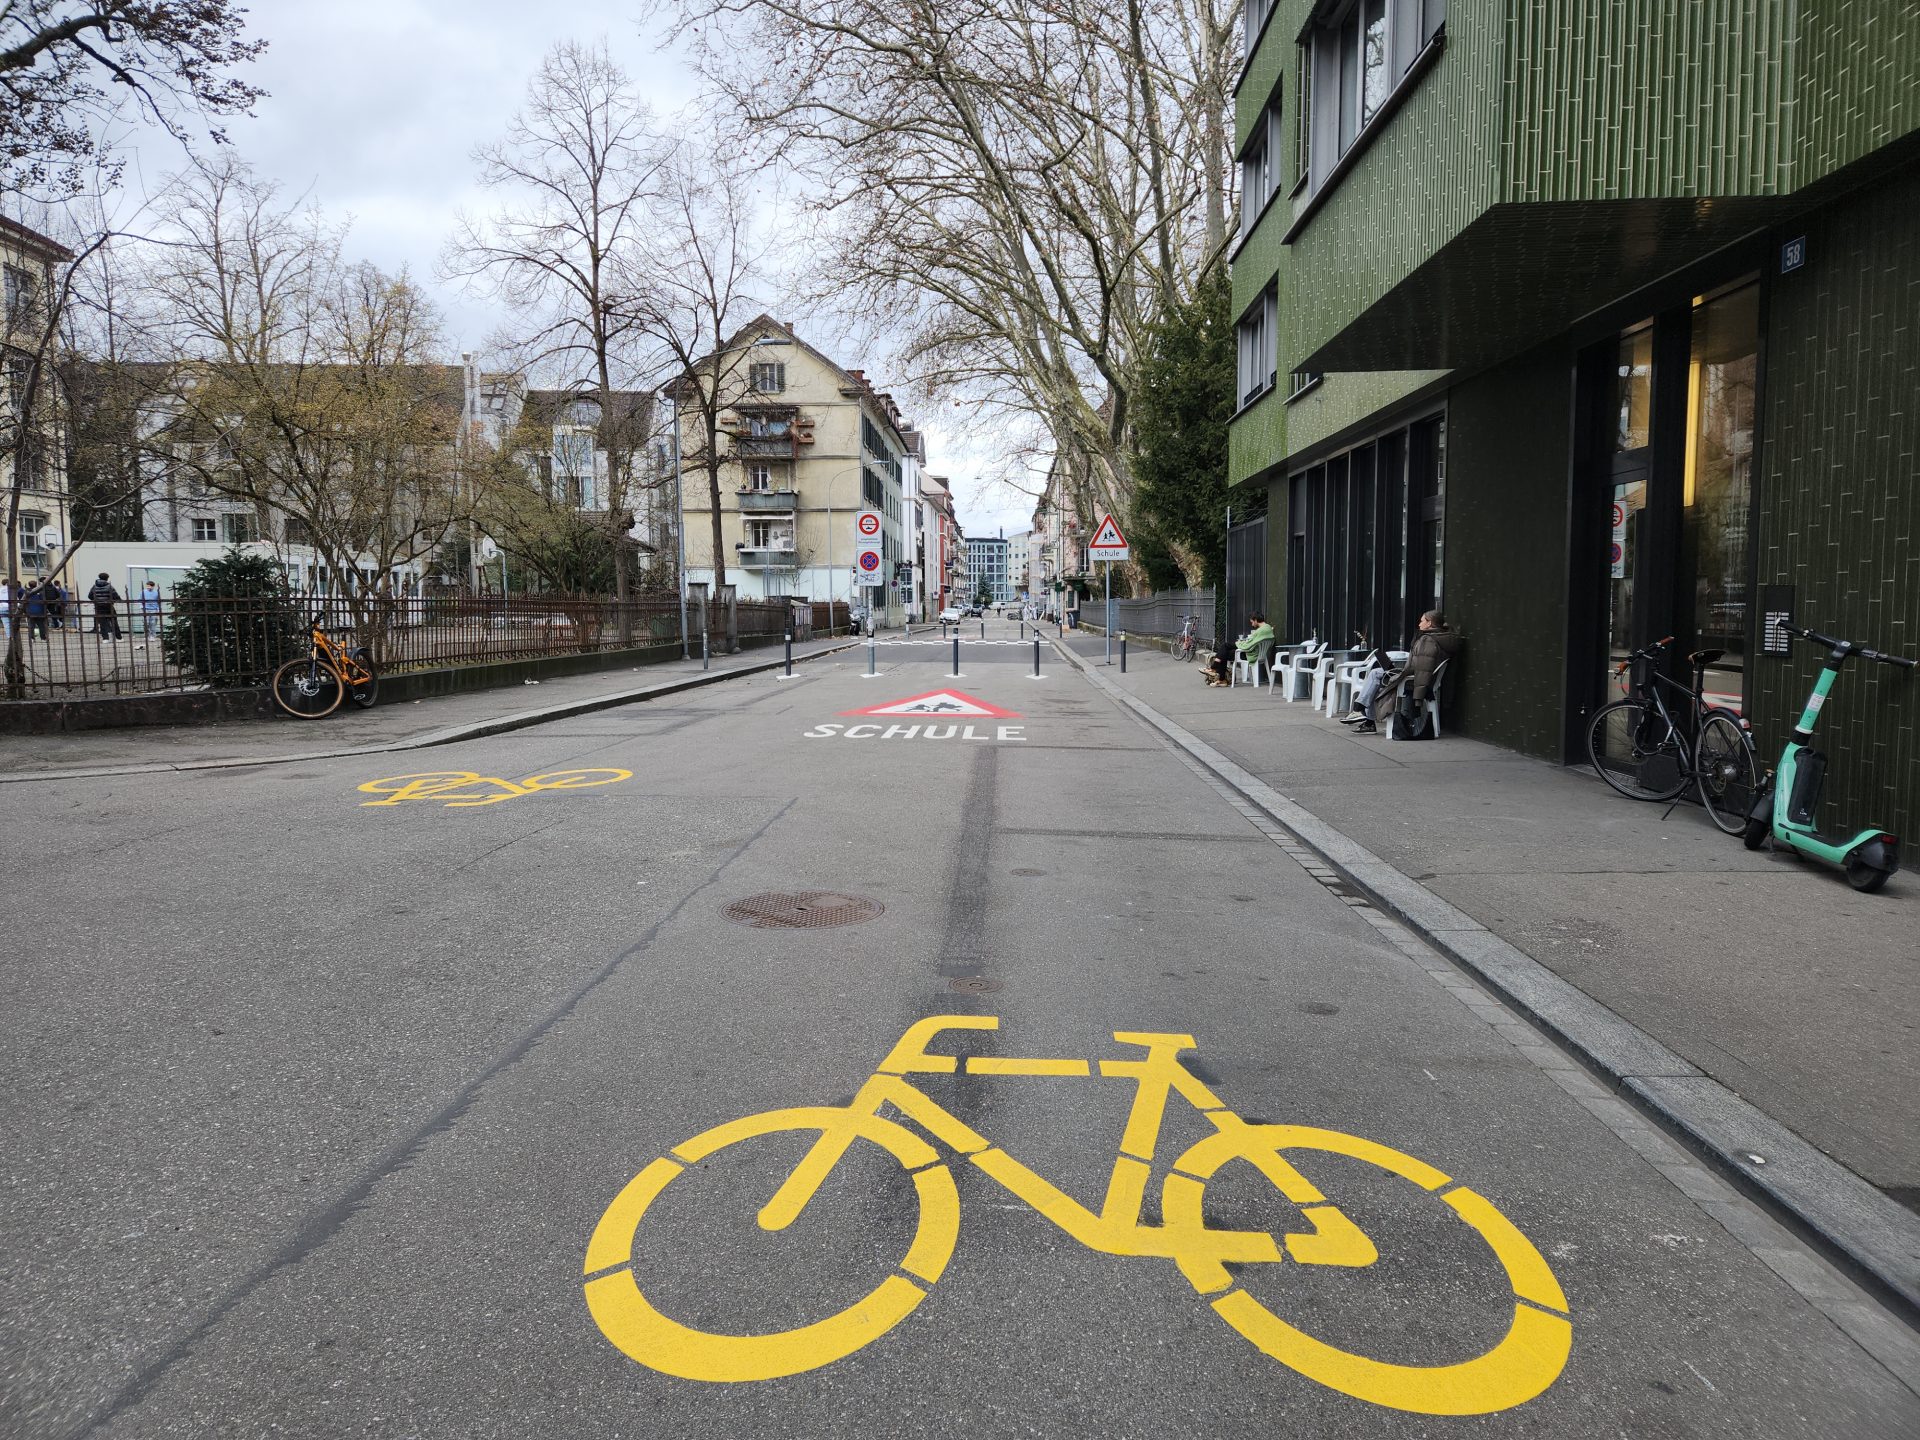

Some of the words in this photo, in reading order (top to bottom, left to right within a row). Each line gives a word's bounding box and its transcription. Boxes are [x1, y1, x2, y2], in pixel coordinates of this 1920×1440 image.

[1786, 243, 1801, 267] 58
[1097, 549, 1120, 557] Schule
[803, 723, 1027, 741] SCHULE
